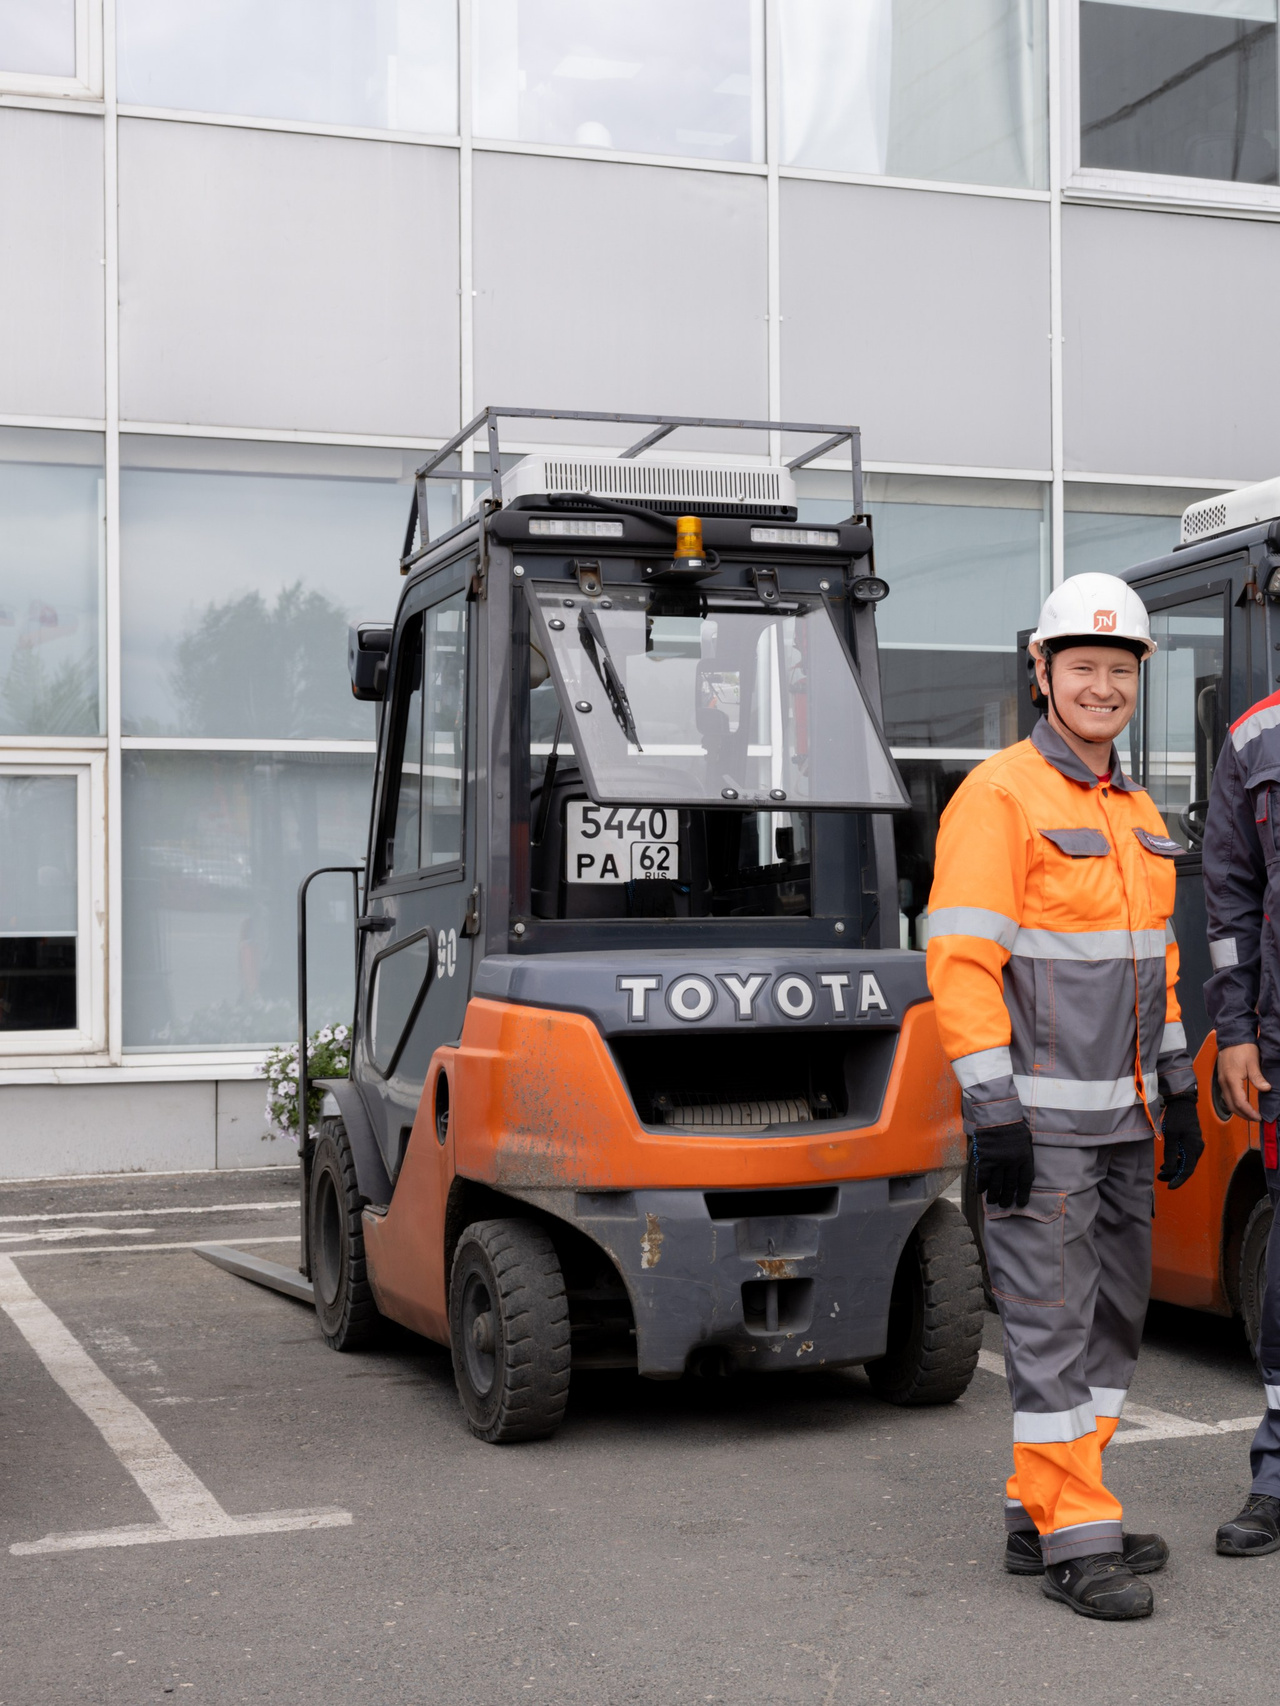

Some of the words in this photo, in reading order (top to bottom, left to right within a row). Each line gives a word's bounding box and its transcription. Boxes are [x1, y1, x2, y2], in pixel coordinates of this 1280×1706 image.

[581, 806, 667, 840] 5440
[640, 845, 670, 871] 62
[618, 973, 888, 1019] TOYOTA
